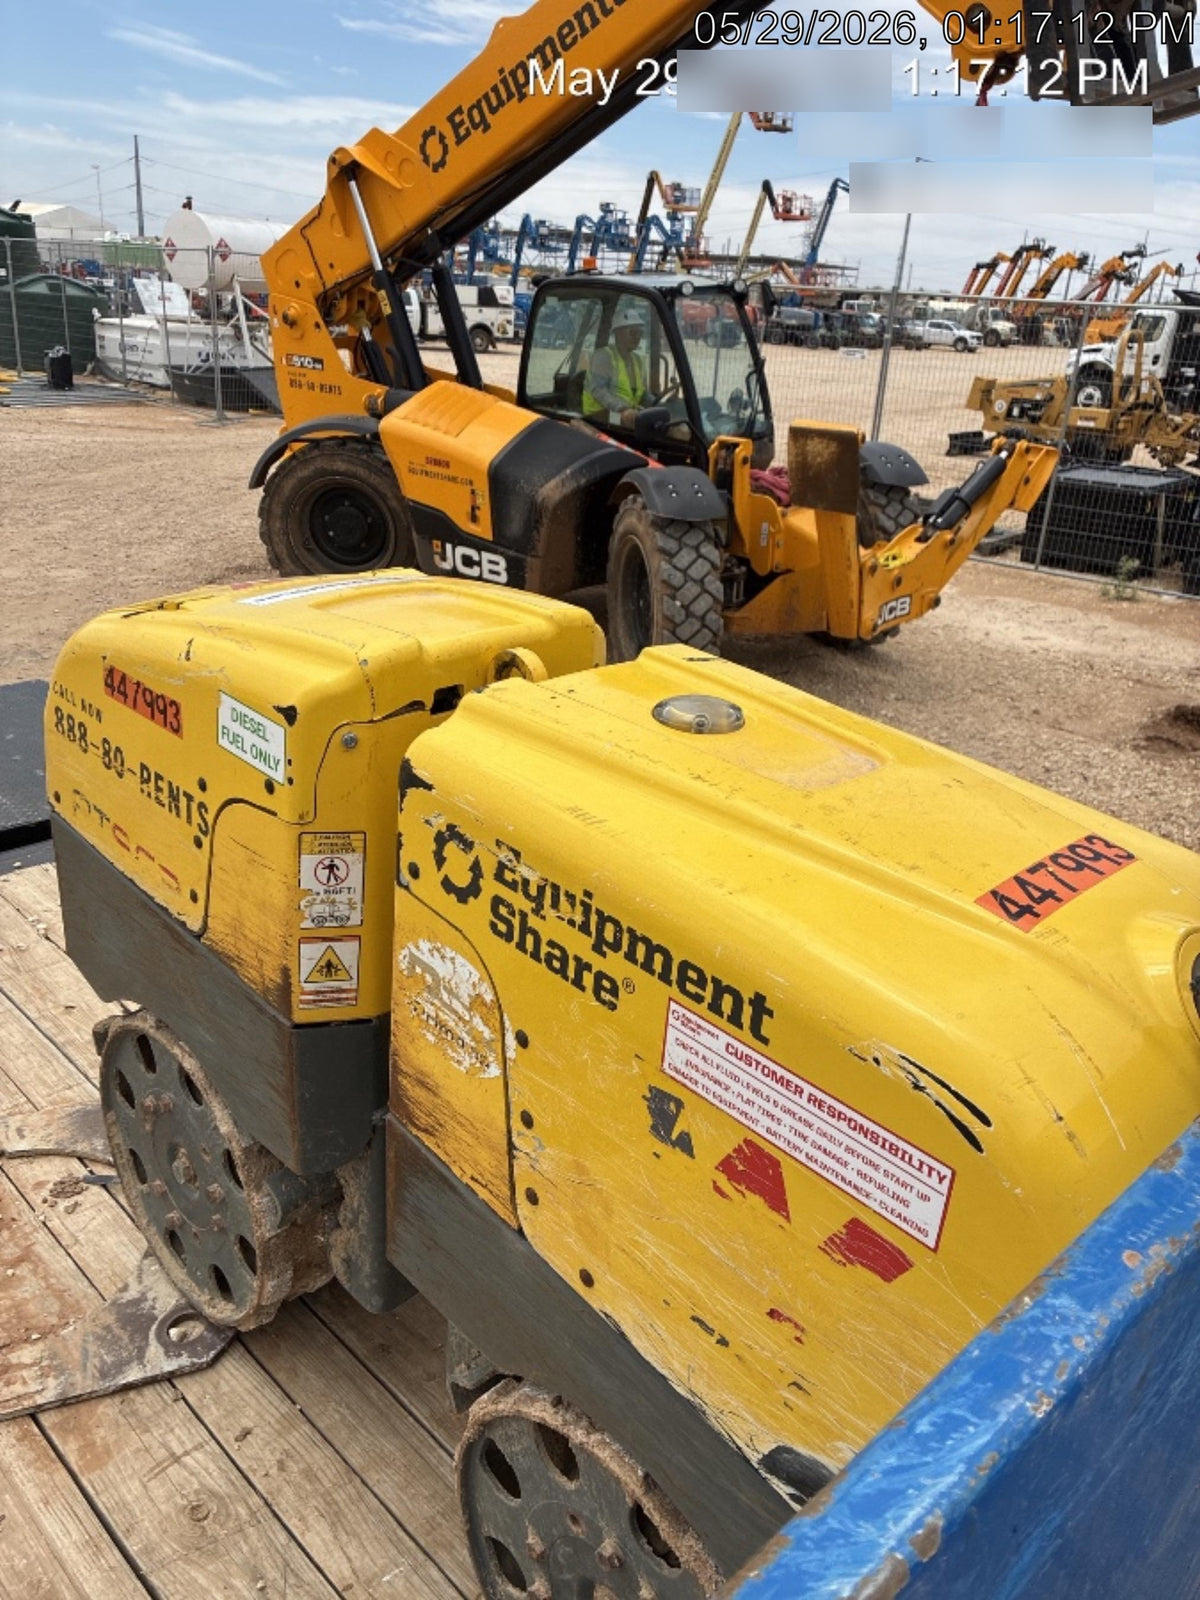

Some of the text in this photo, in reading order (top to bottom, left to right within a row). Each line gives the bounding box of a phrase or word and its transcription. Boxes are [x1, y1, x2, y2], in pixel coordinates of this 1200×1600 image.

[432, 540, 508, 584] JCB
[877, 596, 911, 625] JCB
[52, 680, 102, 724] CALL NOW
[103, 665, 183, 735] 447993
[231, 707, 269, 742] DIESEL
[54, 705, 209, 838] 888-80-RENTS
[221, 725, 281, 773] FUEL ONLY
[990, 835, 1135, 921] 447993
[494, 838, 774, 1047] Equipment
[668, 1062, 930, 1238] DAMAGE TO EQUIPMENT BATTERY MAINTENANCE CLEANING
[675, 1037, 700, 1058] CHECK
[702, 1055, 714, 1068] ALL
[716, 1062, 740, 1084] FLUID
[741, 1079, 771, 1104] LEVELS
[781, 1104, 814, 1131] GREASE
[815, 1126, 843, 1149] DAILY
[844, 1143, 881, 1174] BEFORE
[883, 1168, 914, 1194] START
[916, 1188, 931, 1203] UP
[725, 1041, 947, 1185] CUSTOMER RESPONSIBILITY
[736, 1092, 756, 1108] FLAT
[757, 1105, 783, 1127] TIRES
[789, 1125, 810, 1144] TIRE
[810, 1139, 850, 1170] DAMAGE
[856, 1169, 911, 1209] REFUELING
